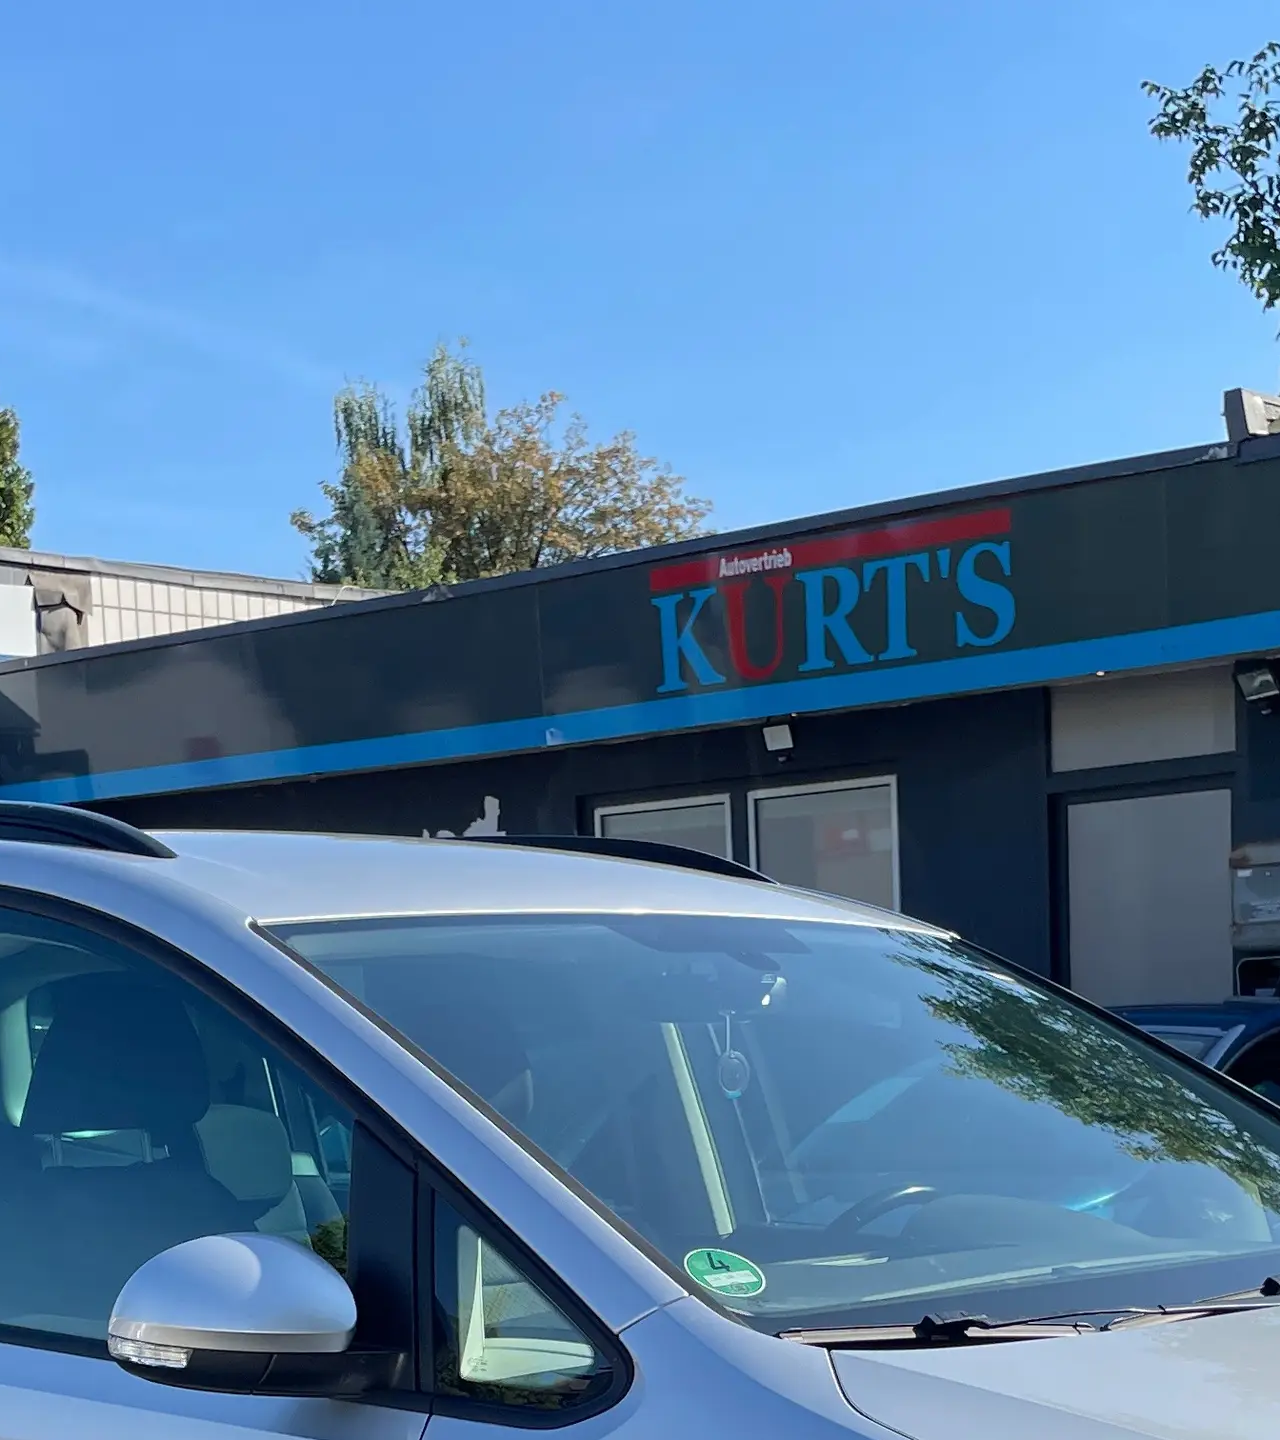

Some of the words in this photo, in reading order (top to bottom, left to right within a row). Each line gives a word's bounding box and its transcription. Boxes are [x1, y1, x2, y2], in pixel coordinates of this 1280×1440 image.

[719, 547, 793, 578] Autovertrieb
[650, 541, 1017, 694] KURT'S
[706, 1252, 731, 1272] 4
